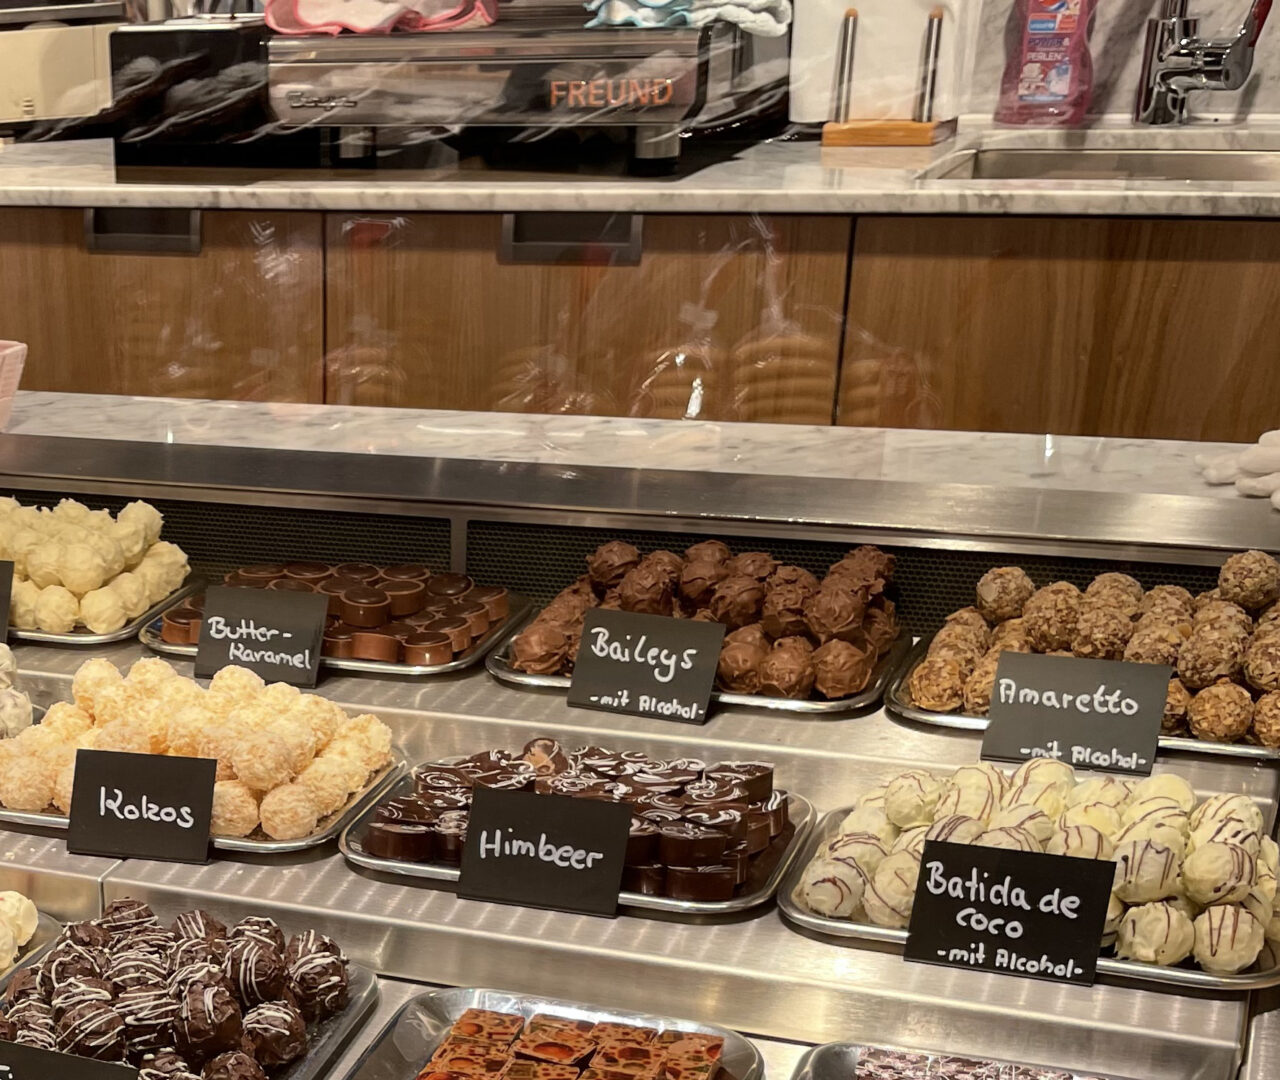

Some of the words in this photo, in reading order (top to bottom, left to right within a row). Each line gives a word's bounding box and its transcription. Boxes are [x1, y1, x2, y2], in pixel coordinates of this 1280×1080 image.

[550, 79, 673, 107] FREUND
[229, 642, 311, 669] Karamel
[590, 627, 697, 682] Baileys
[999, 678, 1138, 715] Amaretto
[100, 786, 194, 828] Kokos
[480, 828, 603, 869] Himbeer
[926, 861, 1031, 910] Batida
[1039, 888, 1080, 919] de
